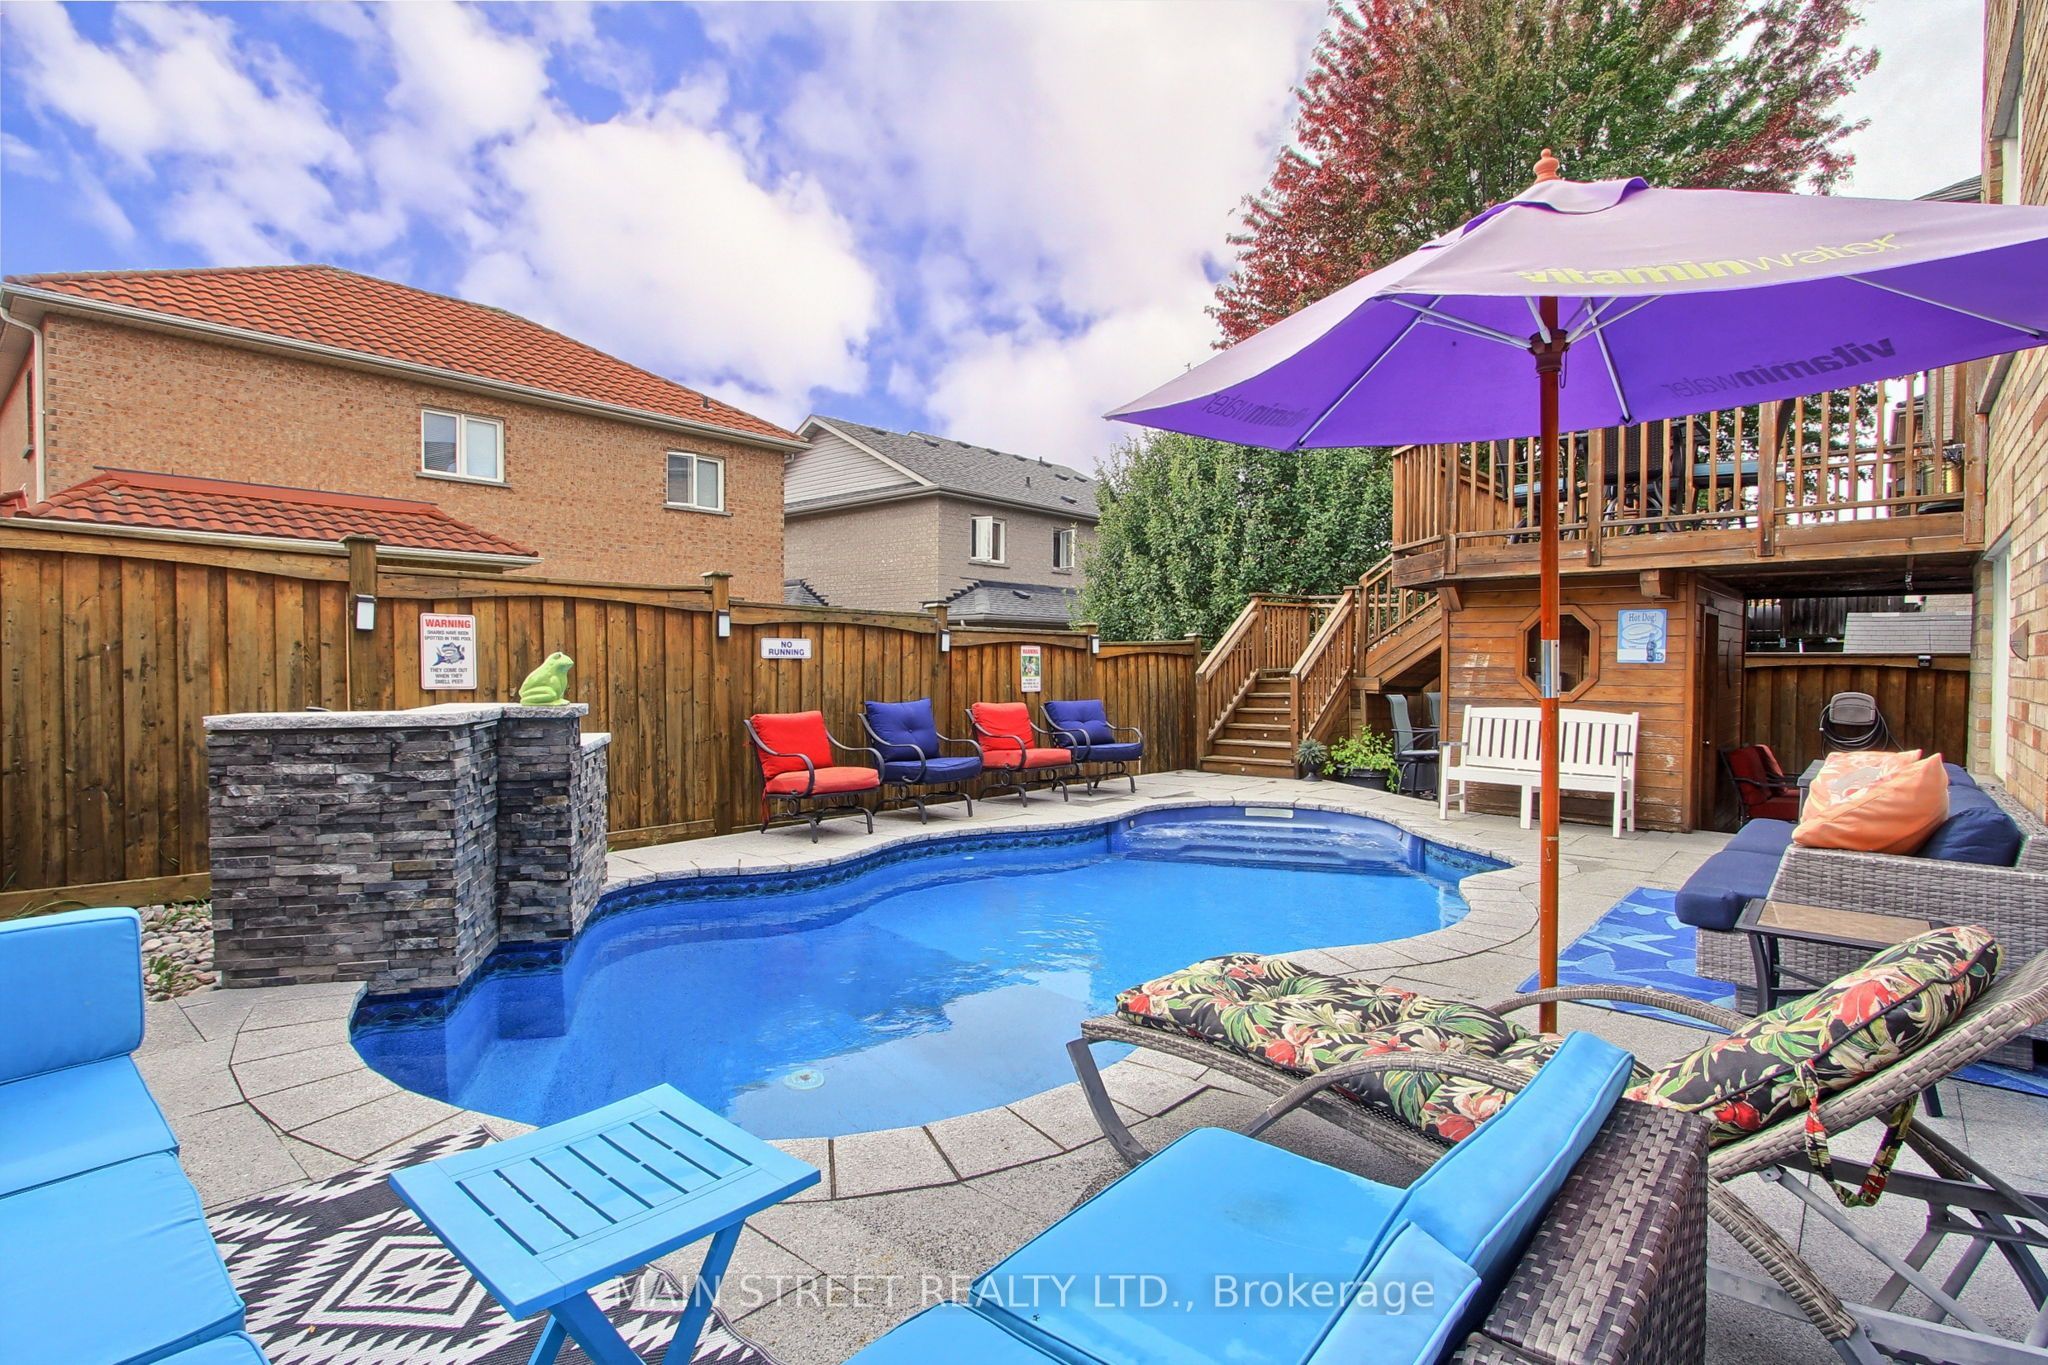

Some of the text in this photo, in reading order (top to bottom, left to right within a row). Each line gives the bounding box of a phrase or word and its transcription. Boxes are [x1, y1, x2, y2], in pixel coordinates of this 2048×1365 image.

[1511, 232, 1900, 286] vitaminwater
[1628, 612, 1657, 623] Hot Dog!
[425, 618, 471, 629] WARNING
